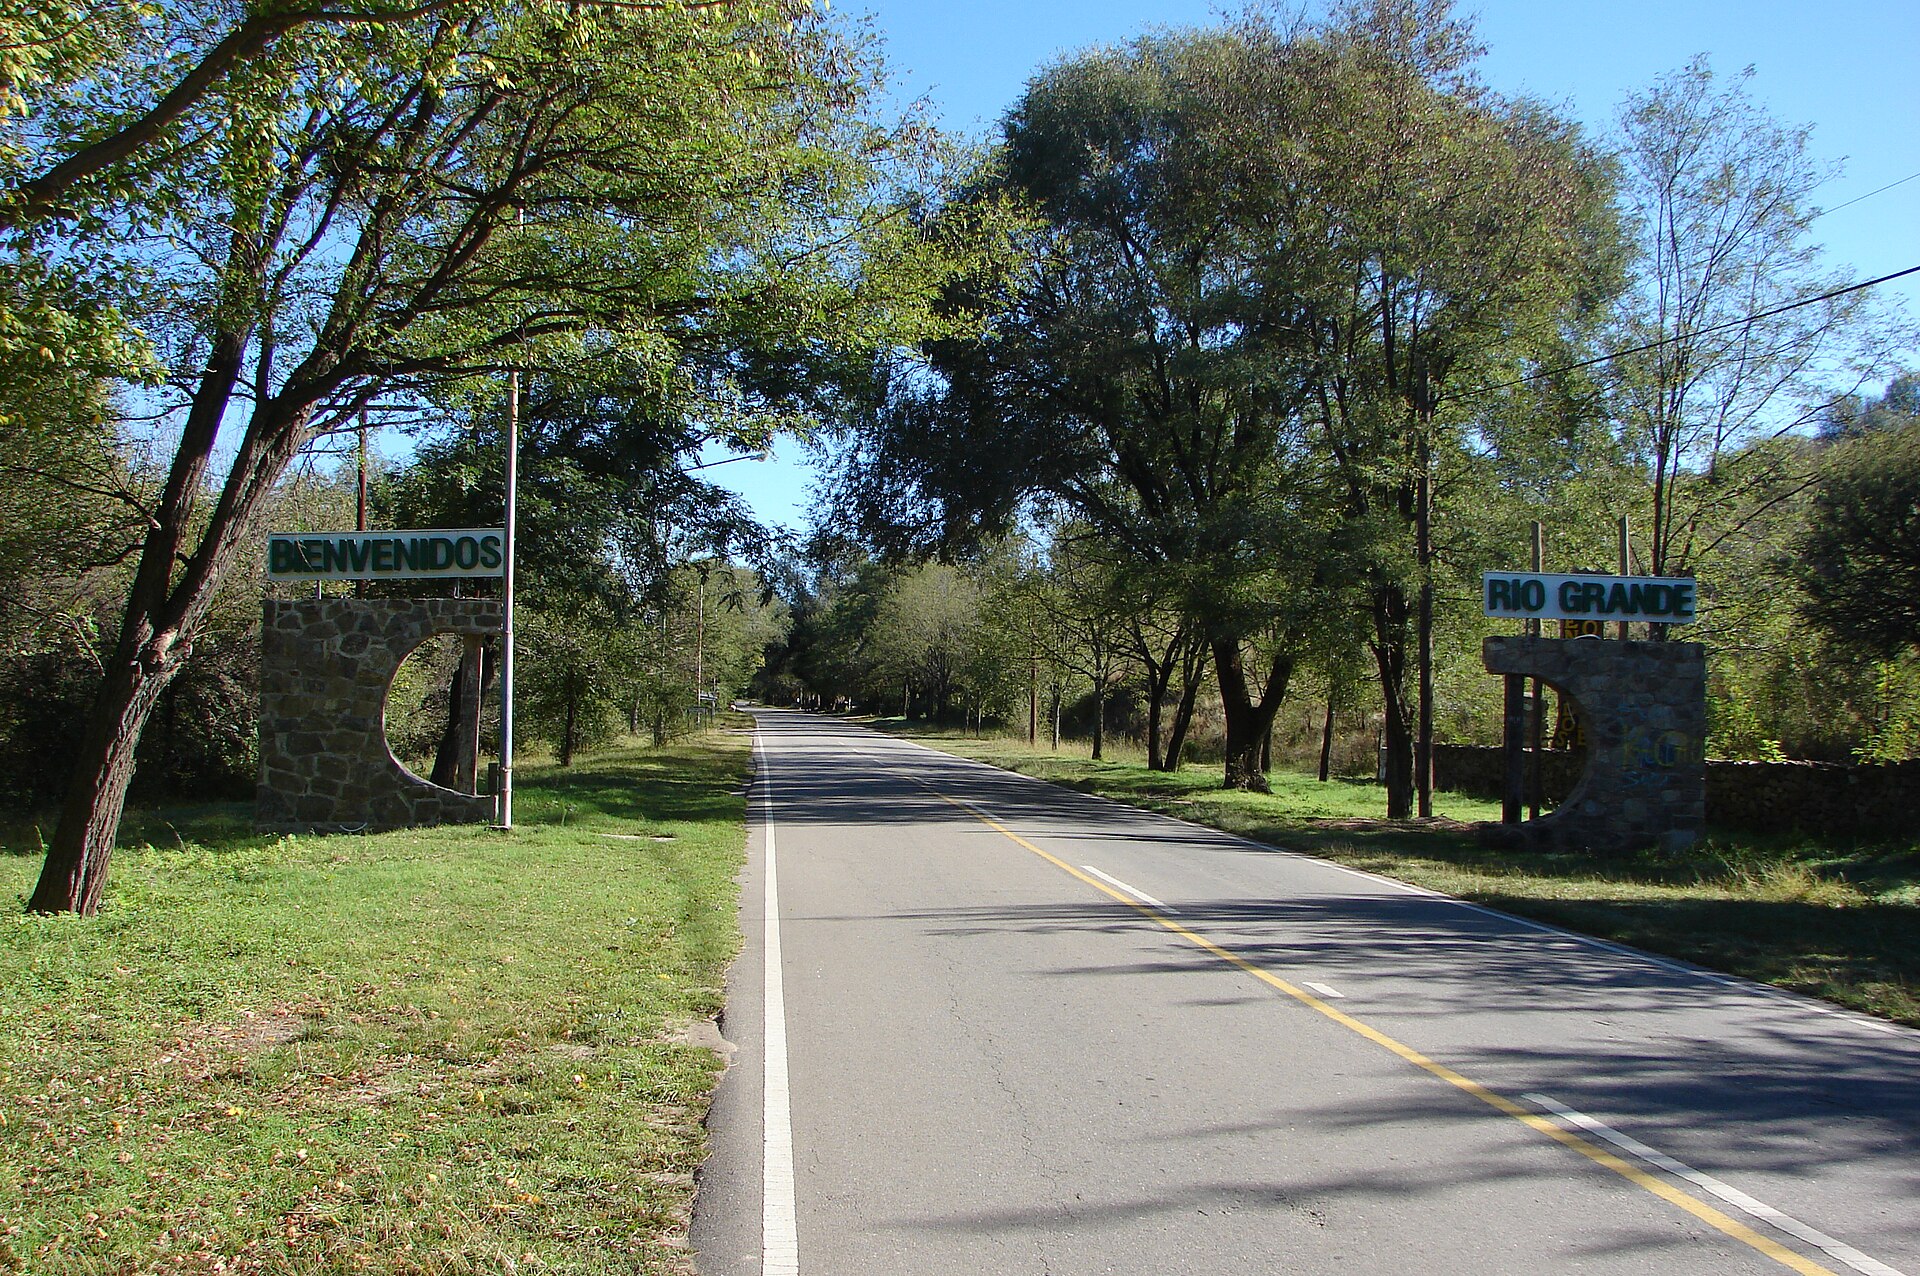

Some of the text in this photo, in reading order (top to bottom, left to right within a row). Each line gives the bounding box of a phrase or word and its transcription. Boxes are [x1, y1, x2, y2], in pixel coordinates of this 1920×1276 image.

[271, 536, 502, 573] BIENVENIDOS
[1488, 579, 1693, 616] RIO GRANDE
